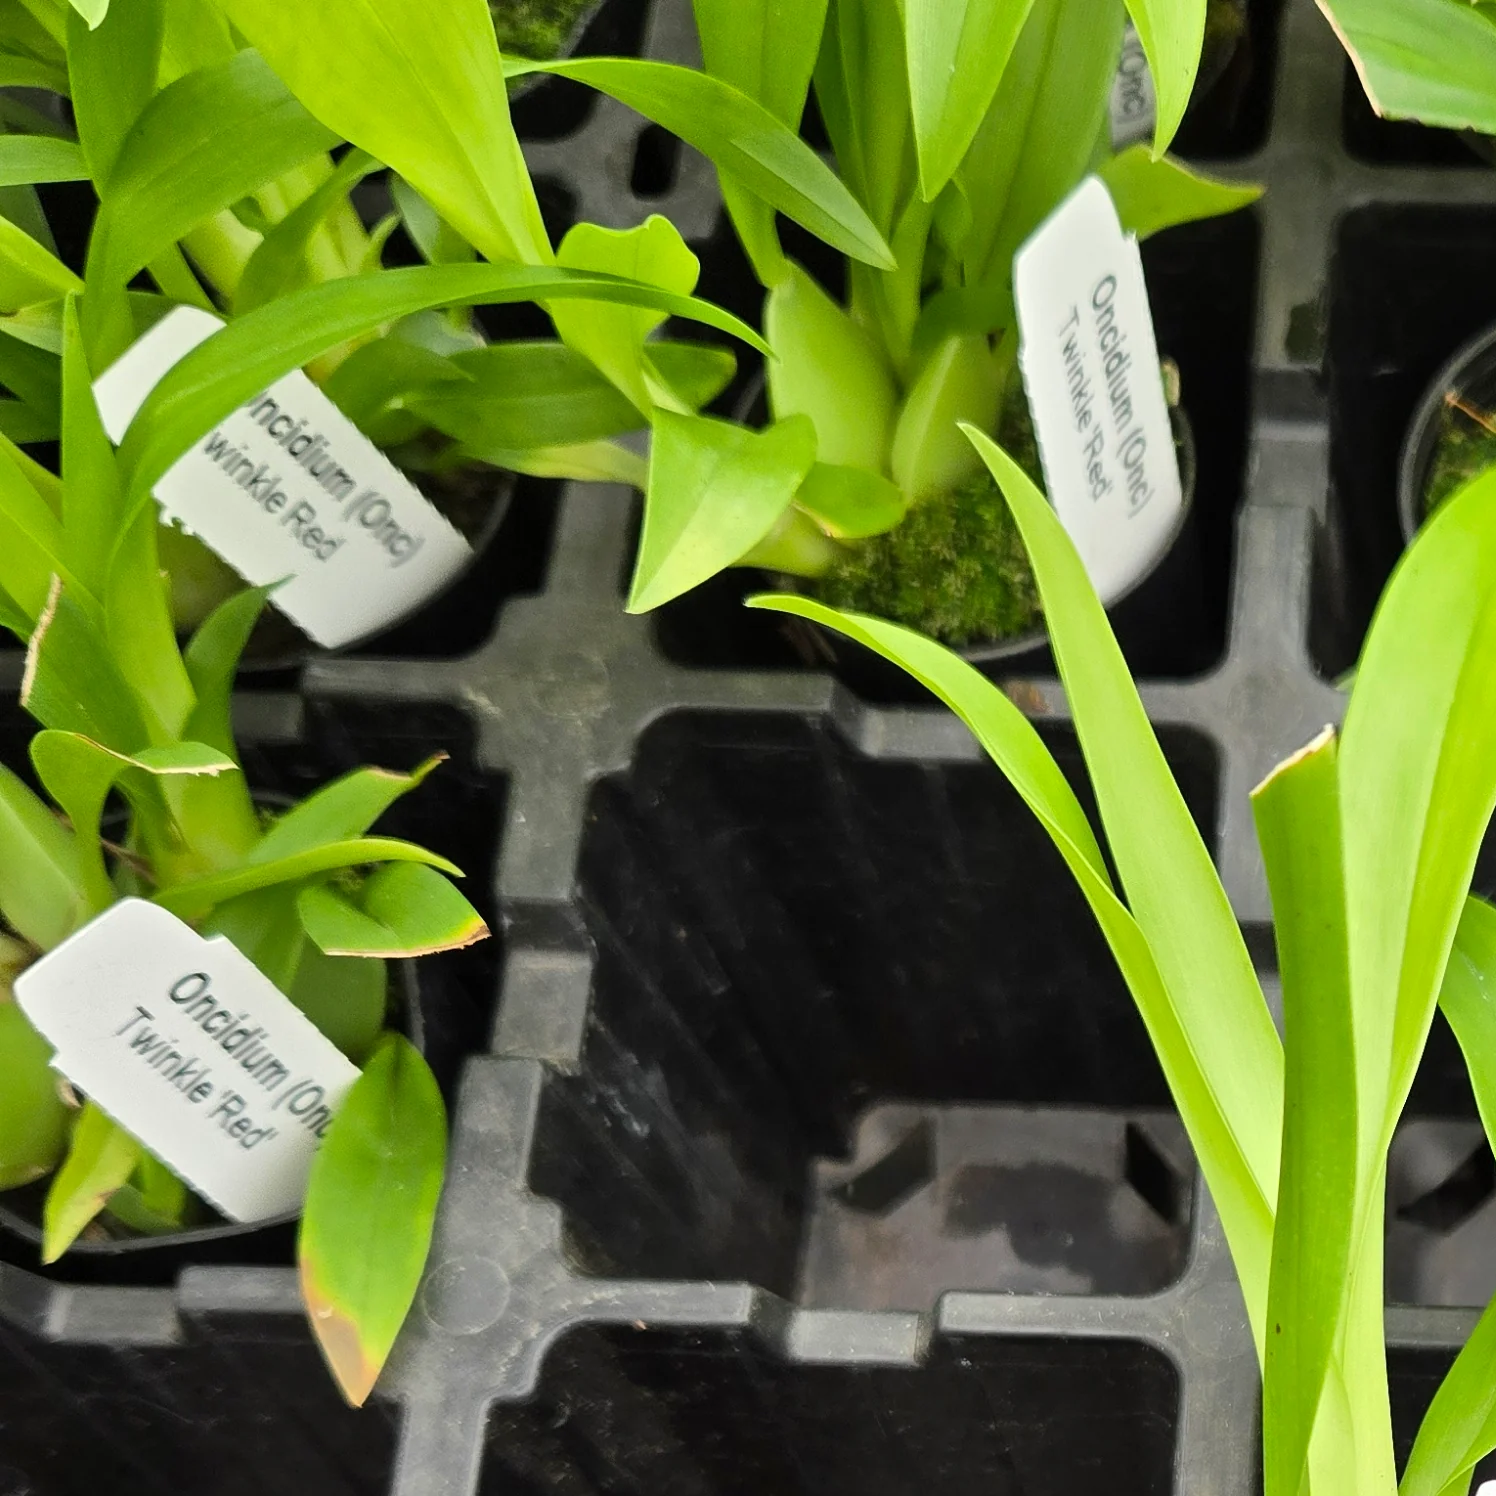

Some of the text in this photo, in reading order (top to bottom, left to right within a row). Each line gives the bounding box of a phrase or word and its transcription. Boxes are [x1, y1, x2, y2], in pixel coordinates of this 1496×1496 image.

[1059, 305, 1093, 434] Twinkle
[1092, 273, 1154, 519] Oncidium (Onc)
[203, 431, 288, 514] winkle
[248, 390, 427, 568] ncidium (Onc)
[114, 1005, 279, 1150] Twinkle 'Red'
[168, 971, 290, 1093] Oncidium
